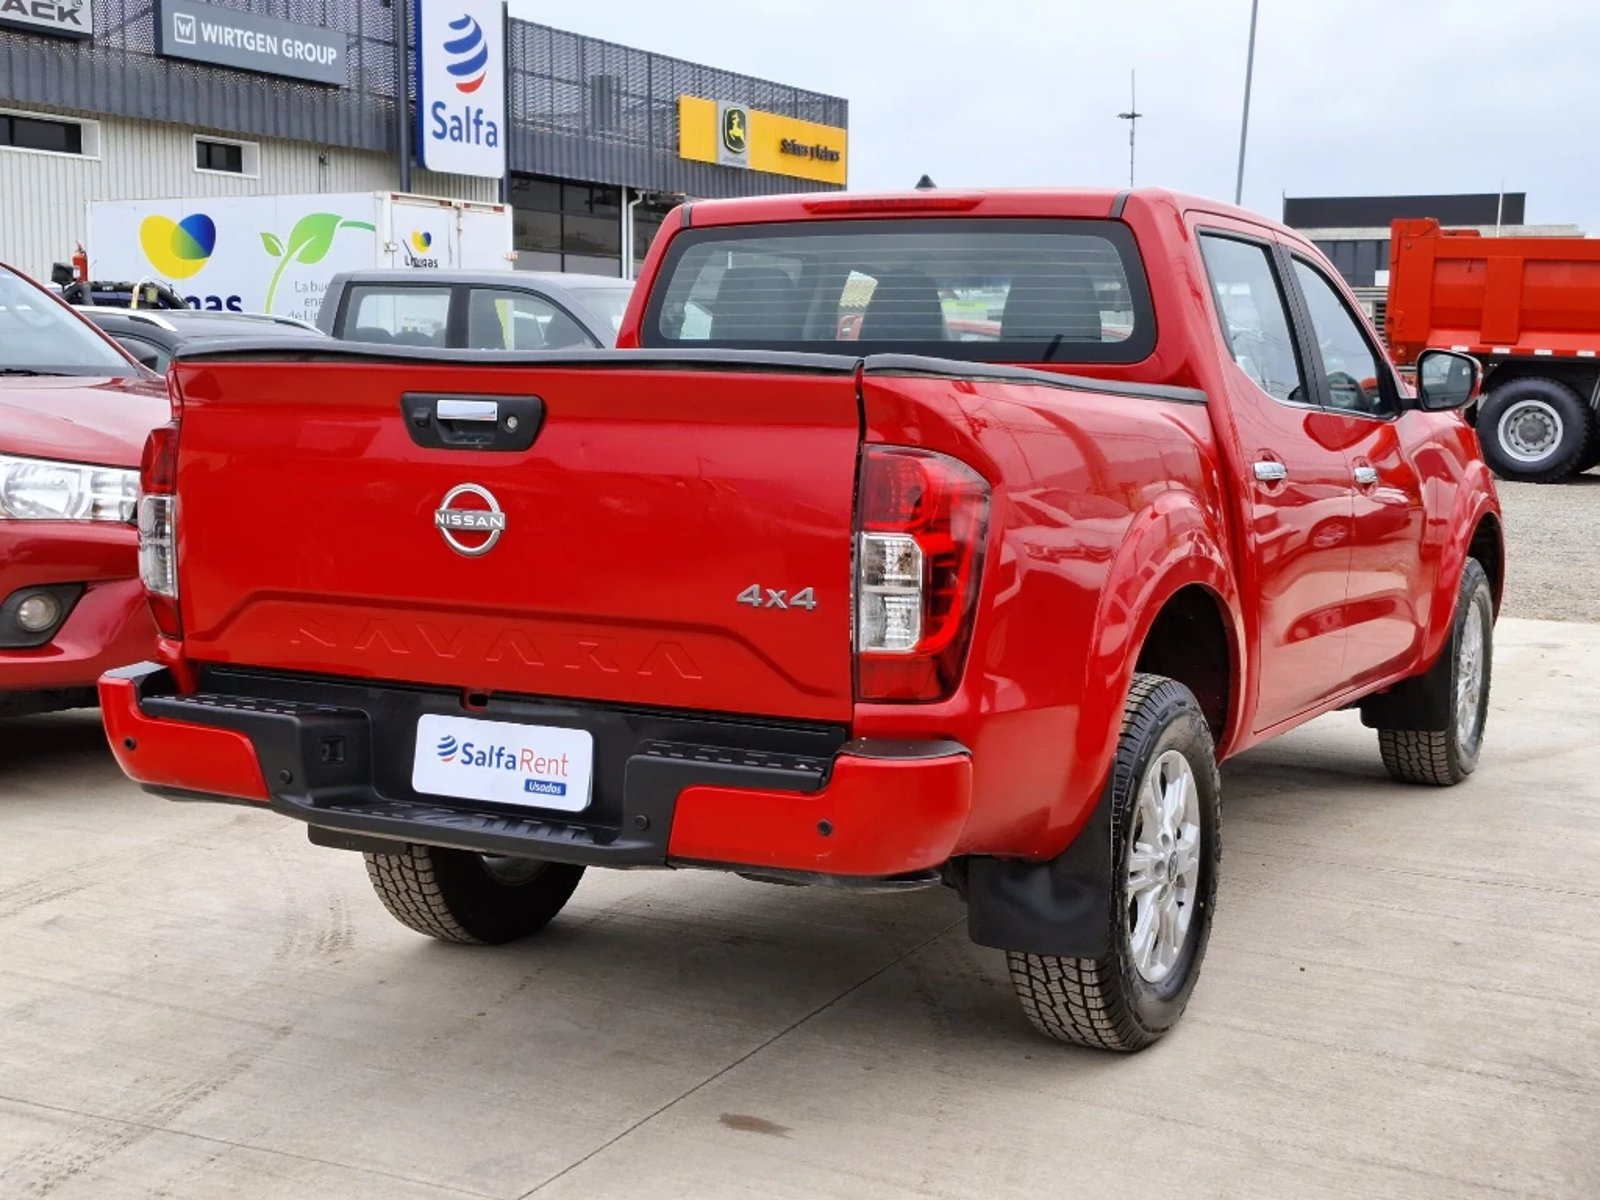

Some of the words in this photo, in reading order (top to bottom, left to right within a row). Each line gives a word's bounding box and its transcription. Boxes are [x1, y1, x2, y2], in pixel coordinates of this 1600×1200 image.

[201, 22, 278, 55] WIRTGEN
[282, 38, 338, 65] GROUP
[431, 101, 498, 148] Salfa
[435, 512, 503, 528] NISSAN
[736, 583, 817, 610] 4x4
[289, 610, 703, 680] NAVARA
[529, 781, 562, 795] Usados
